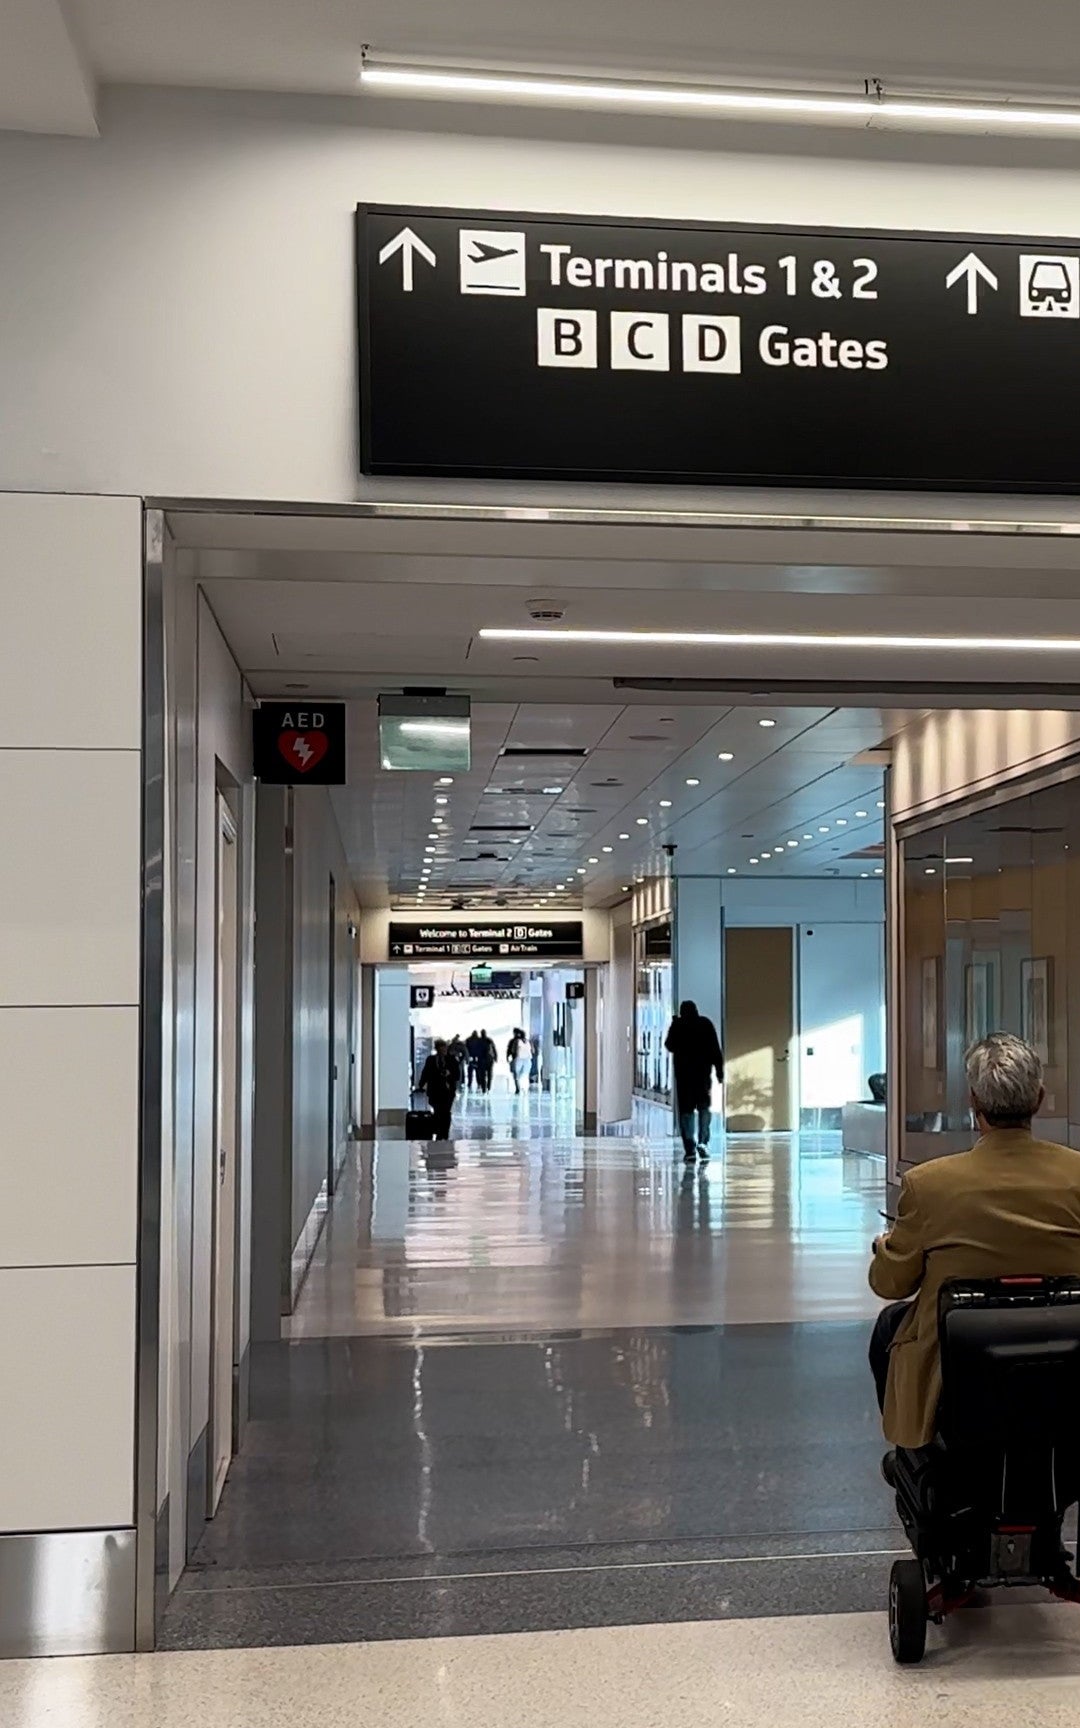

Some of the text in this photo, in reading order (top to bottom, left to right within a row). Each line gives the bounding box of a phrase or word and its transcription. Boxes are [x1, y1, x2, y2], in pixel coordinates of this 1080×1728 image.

[540, 244, 878, 300] Terminals 1 & 2
[554, 318, 889, 370] B C D Gates
[281, 712, 325, 728] AED
[419, 928, 457, 939] Welcome
[458, 929, 467, 938] to
[468, 928, 505, 938] Terminal
[506, 928, 513, 938] 2
[528, 928, 553, 938] Gates
[415, 944, 445, 953] Terminal
[446, 945, 451, 953] 1
[472, 945, 493, 953] Gates
[510, 944, 538, 953] AirTrain
